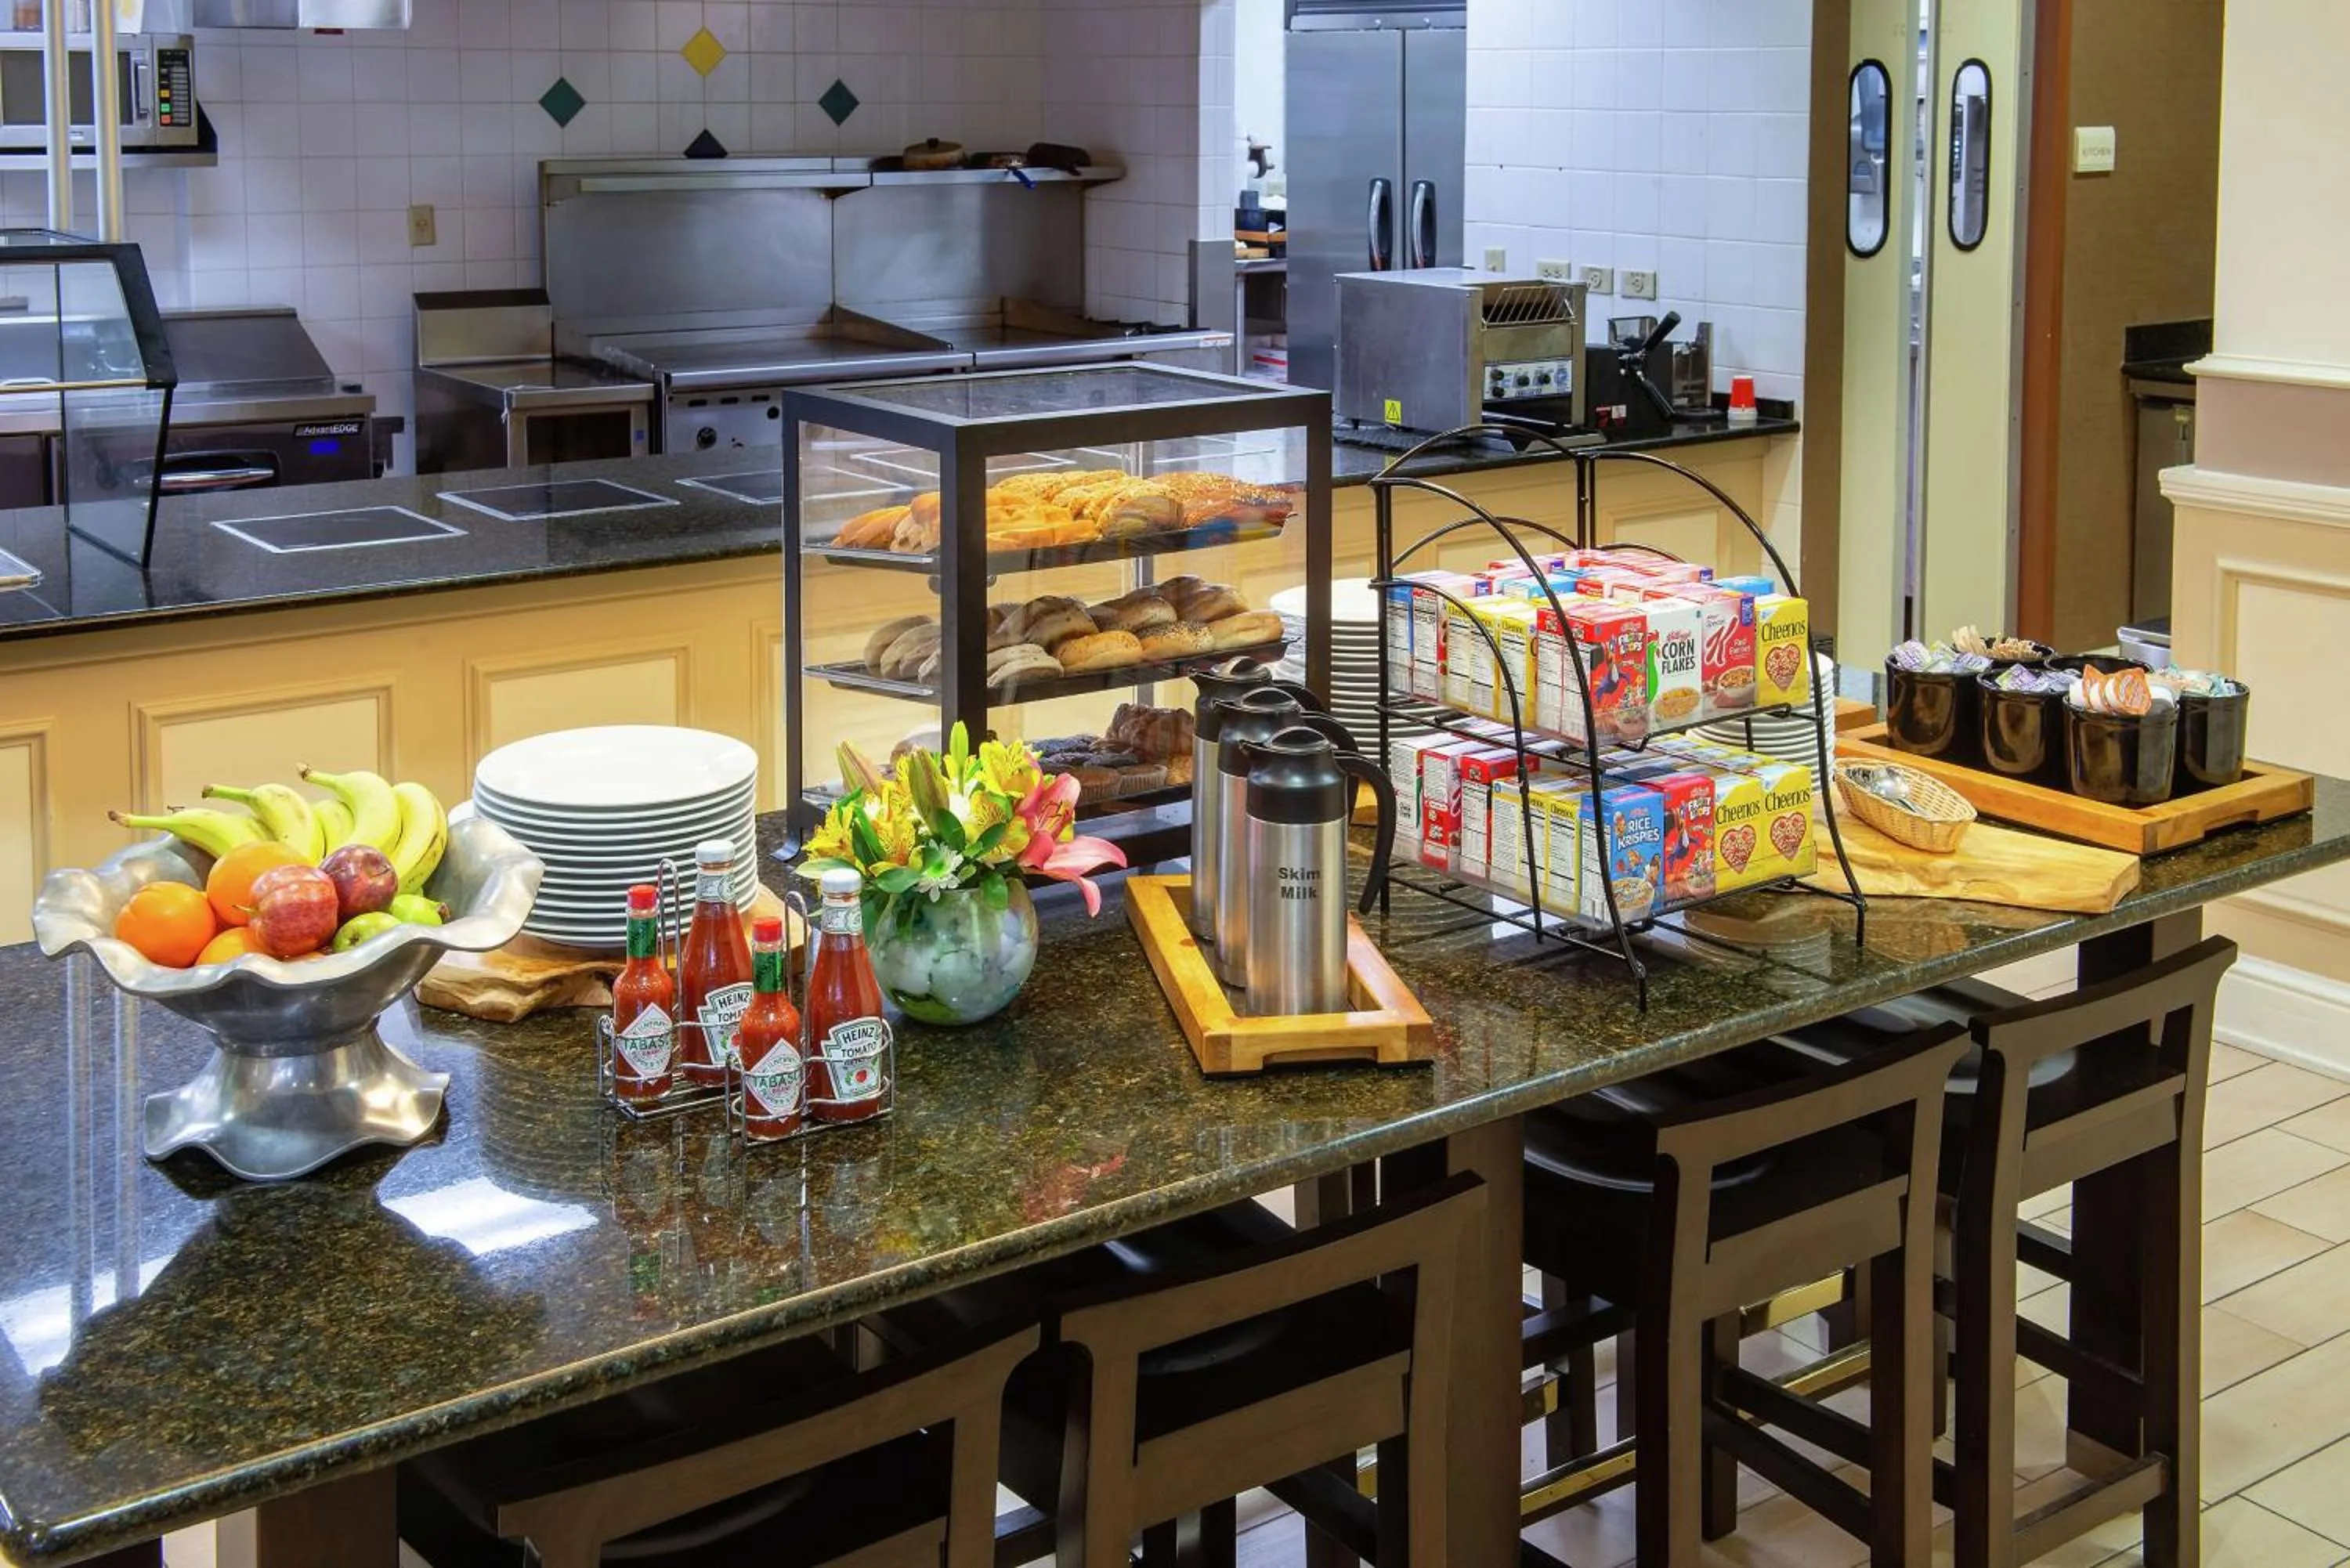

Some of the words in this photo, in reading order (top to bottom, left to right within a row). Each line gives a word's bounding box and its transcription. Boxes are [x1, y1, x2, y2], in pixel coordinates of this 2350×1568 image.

[1762, 621, 1806, 641] Cheerios
[1661, 638, 1695, 659] CORN
[1661, 656, 1696, 674] FLAKES
[1765, 788, 1810, 811] Cheerios
[1716, 801, 1760, 824] Cheerios
[1629, 817, 1651, 832] RICE
[1618, 829, 1659, 851] KRISPIES
[1278, 867, 1320, 880] Skim
[1281, 886, 1317, 900] Milk
[718, 992, 750, 1008] HEINZ
[842, 1027, 875, 1044] HEINZ
[841, 1041, 877, 1057] TOMATO
